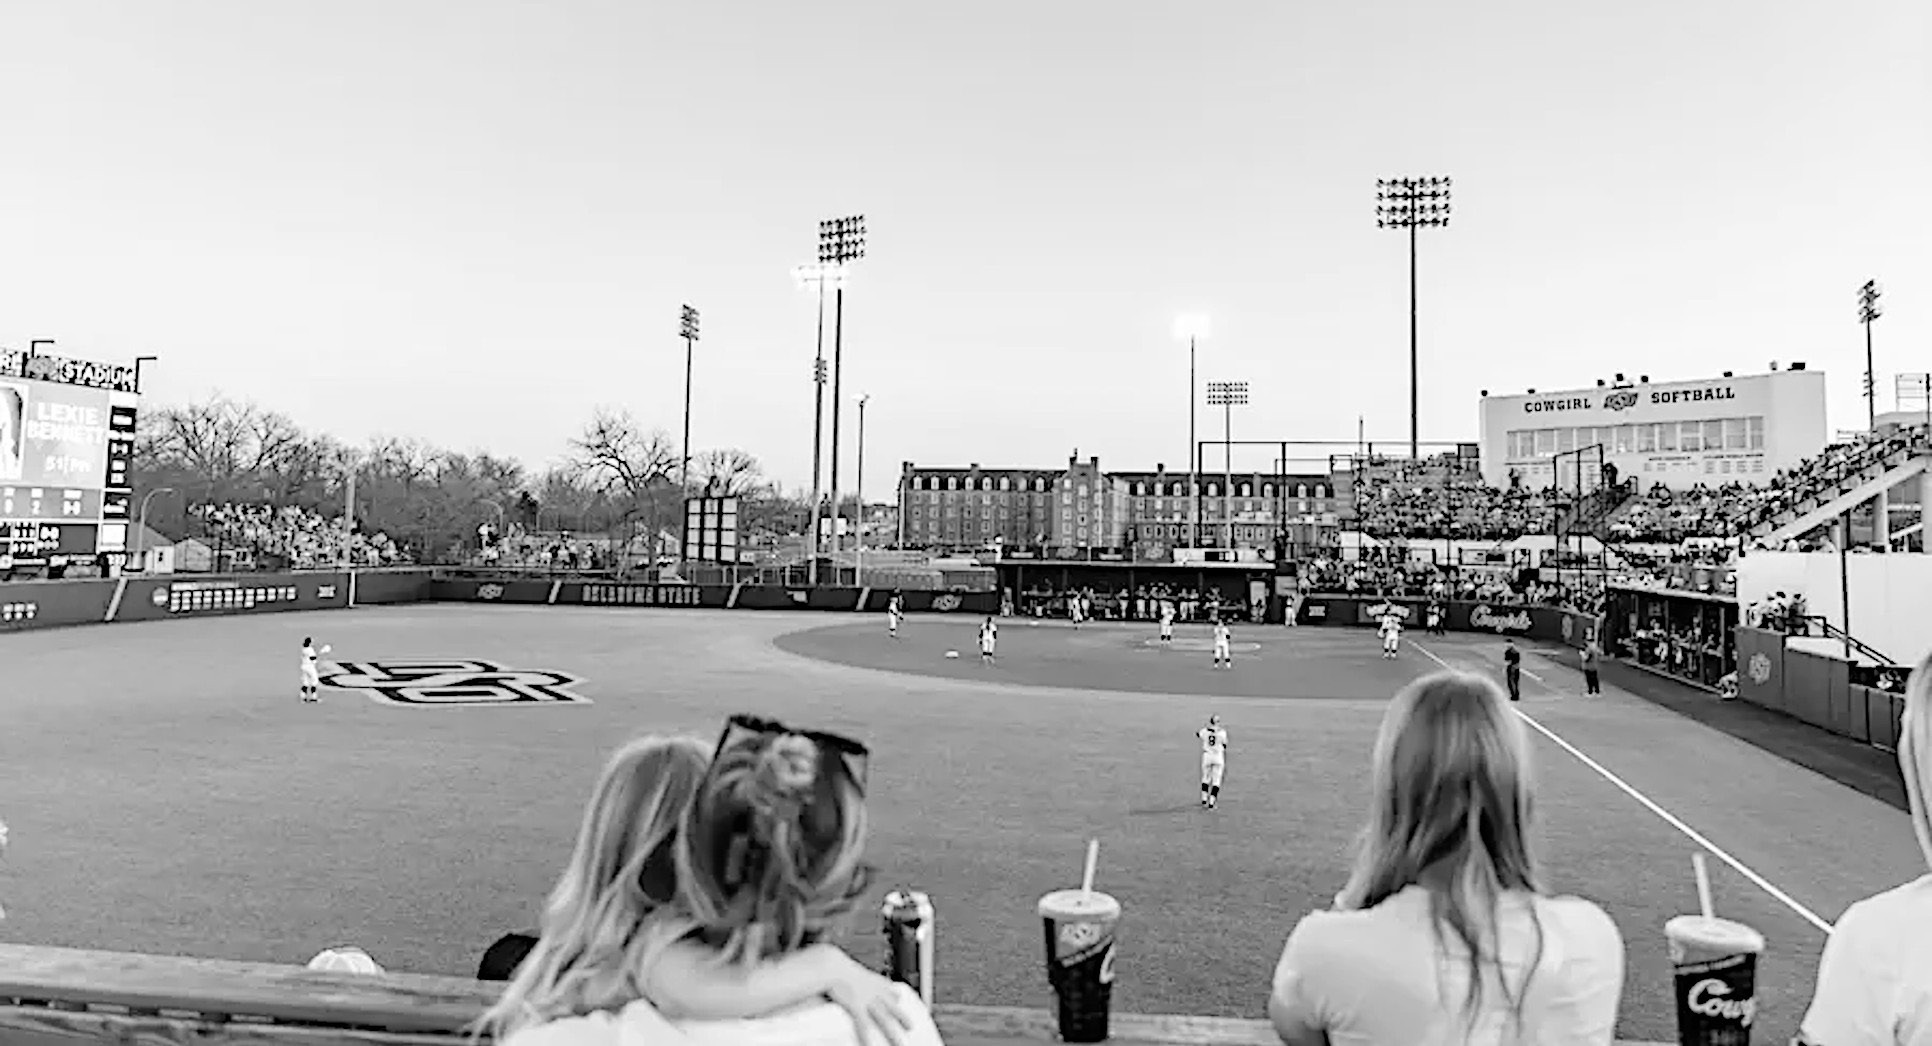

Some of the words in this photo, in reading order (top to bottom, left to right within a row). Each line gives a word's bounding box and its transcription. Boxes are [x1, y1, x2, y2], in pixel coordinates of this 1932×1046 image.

[61, 362, 135, 387] STADIUM
[1524, 398, 1592, 413] COWGIRL
[1651, 387, 1735, 403] SOFTBALL
[38, 402, 99, 425] LEXIE
[27, 420, 105, 444] BENNETT
